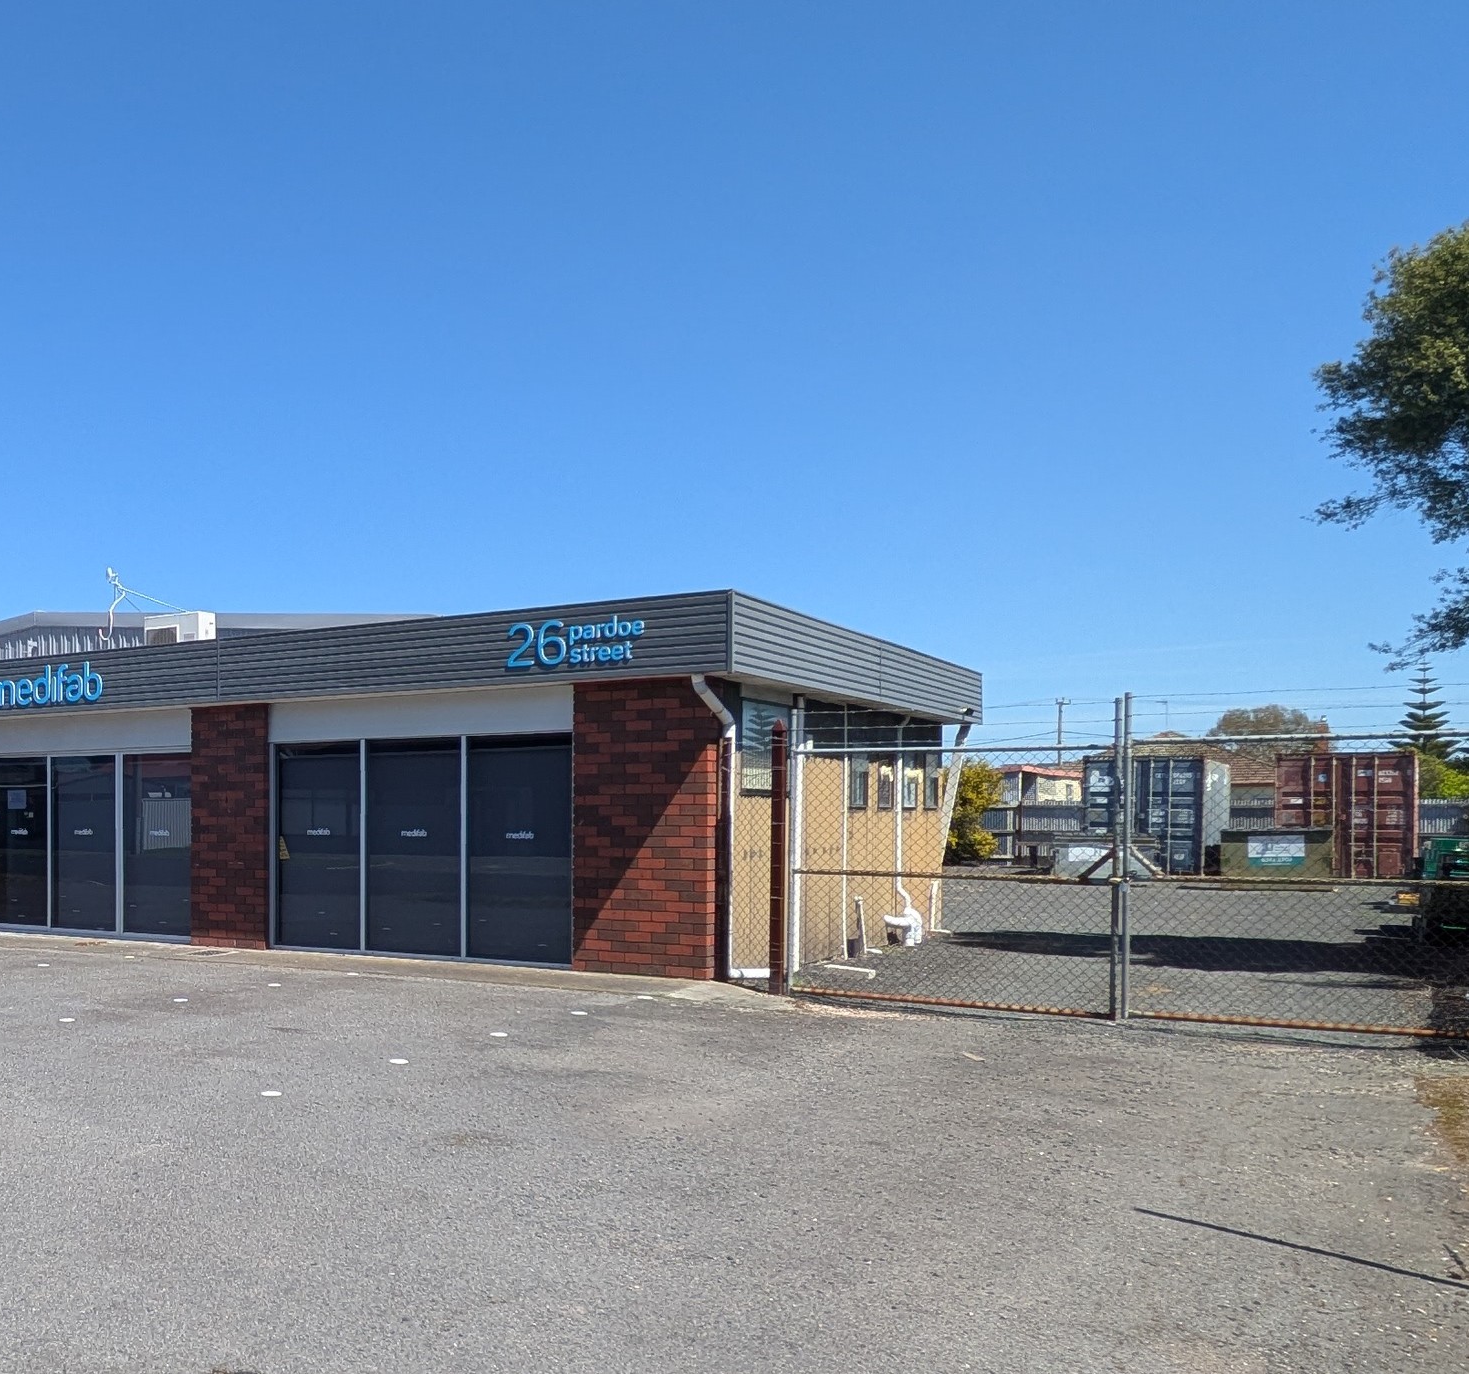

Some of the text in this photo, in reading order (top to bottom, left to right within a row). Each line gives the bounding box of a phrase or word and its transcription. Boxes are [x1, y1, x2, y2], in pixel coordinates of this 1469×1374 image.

[569, 615, 645, 646] pardoe
[507, 619, 567, 667] 26
[569, 640, 633, 664] street
[306, 828, 331, 836] medifab
[400, 828, 428, 838] medifab
[505, 830, 535, 840] medifab
